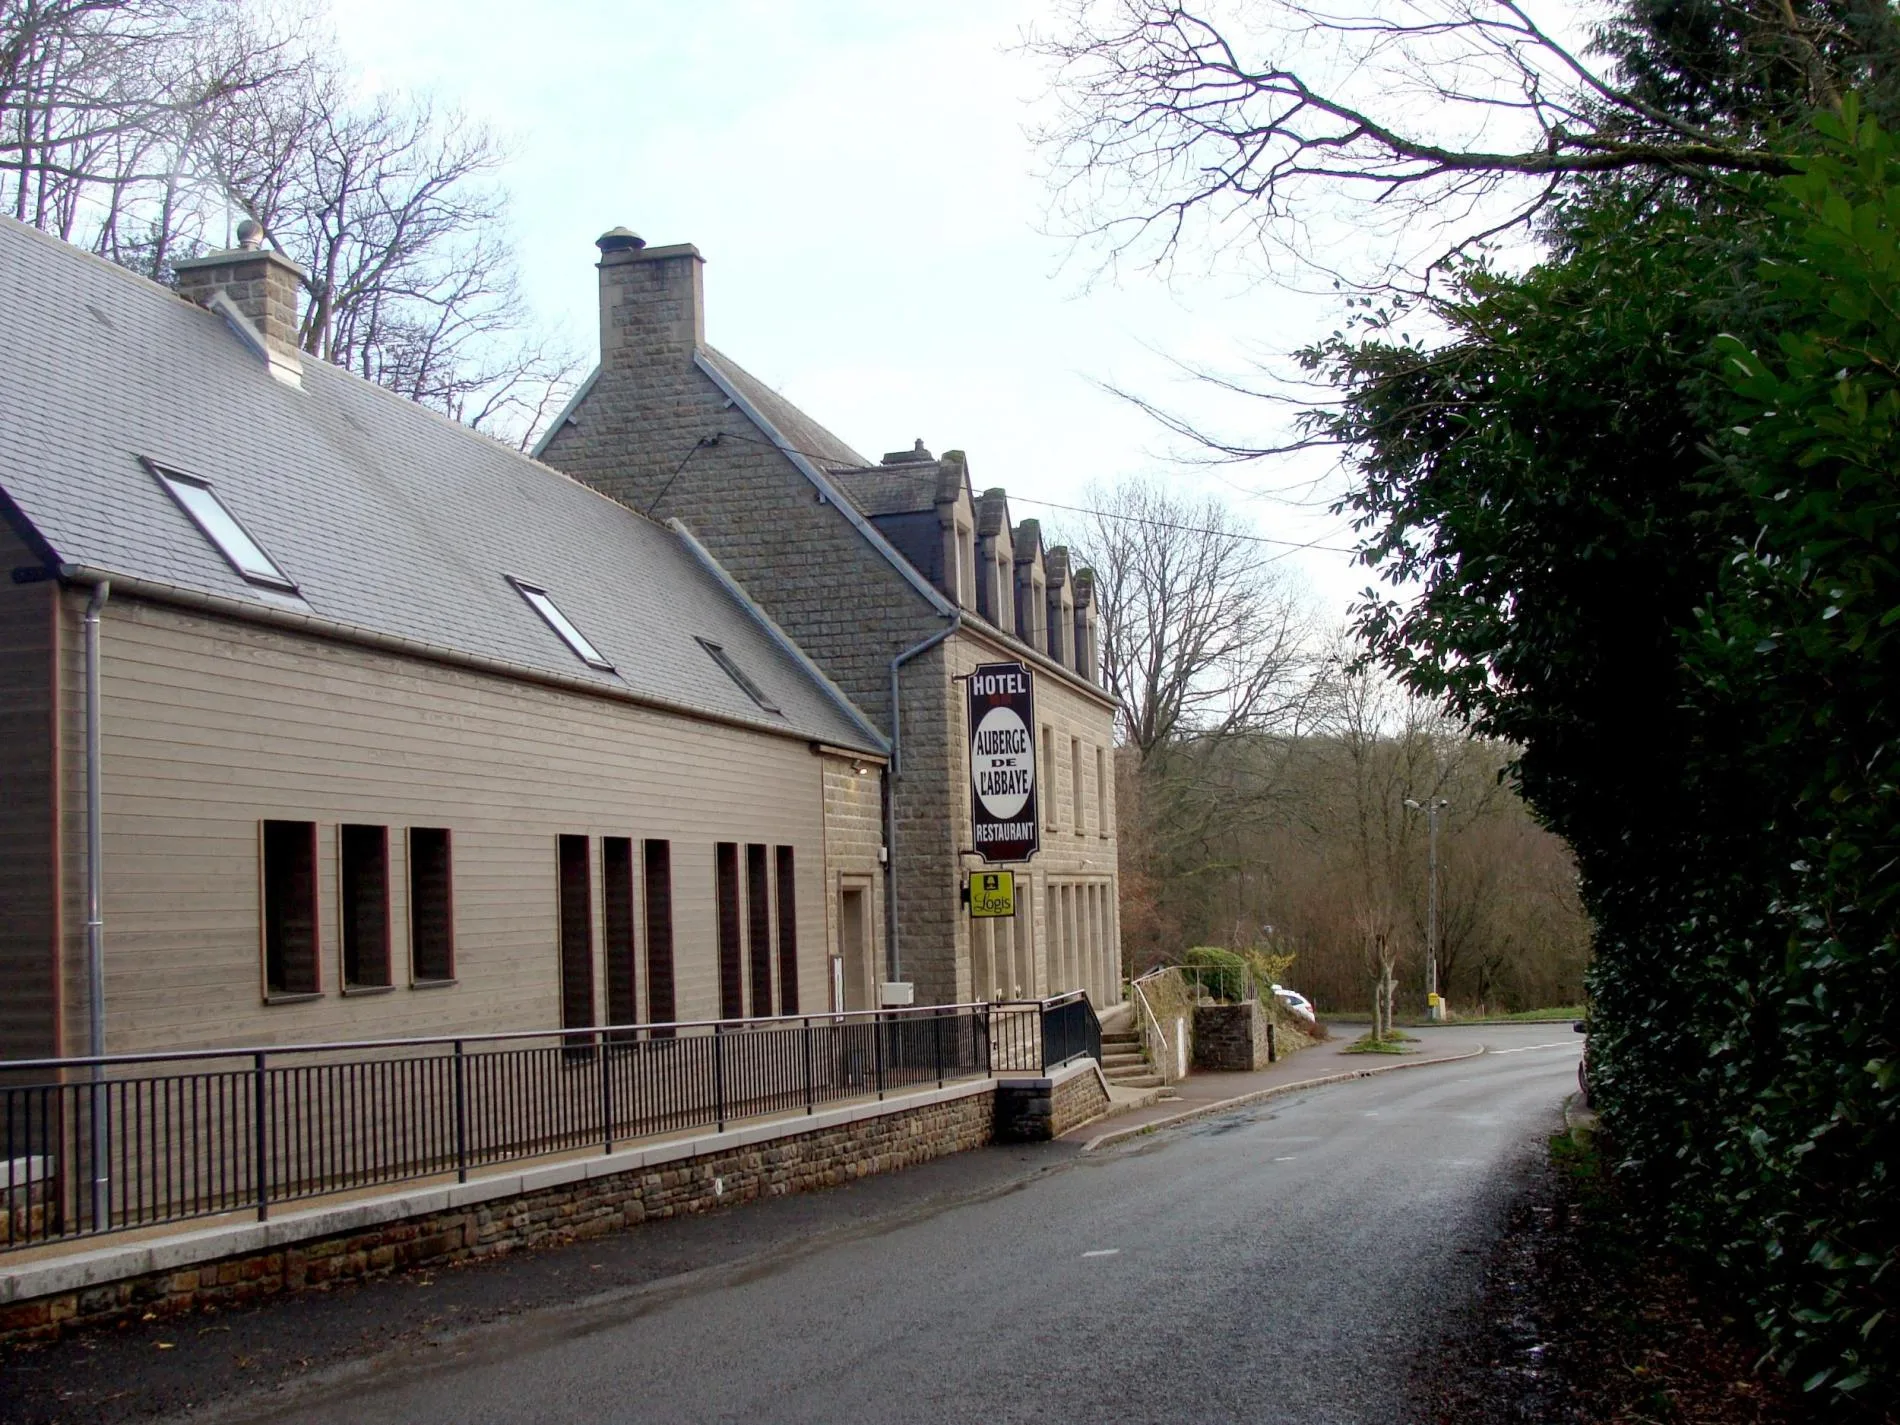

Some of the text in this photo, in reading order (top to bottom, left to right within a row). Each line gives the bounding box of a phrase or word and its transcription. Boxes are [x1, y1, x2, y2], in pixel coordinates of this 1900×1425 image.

[973, 673, 1026, 696] HOTEL
[976, 729, 1026, 755] AUBERGE
[991, 758, 1017, 768] DE
[980, 770, 1028, 796] L'ABBAYE
[976, 822, 1035, 842] RESTAURANT
[974, 892, 1011, 913] Logis
